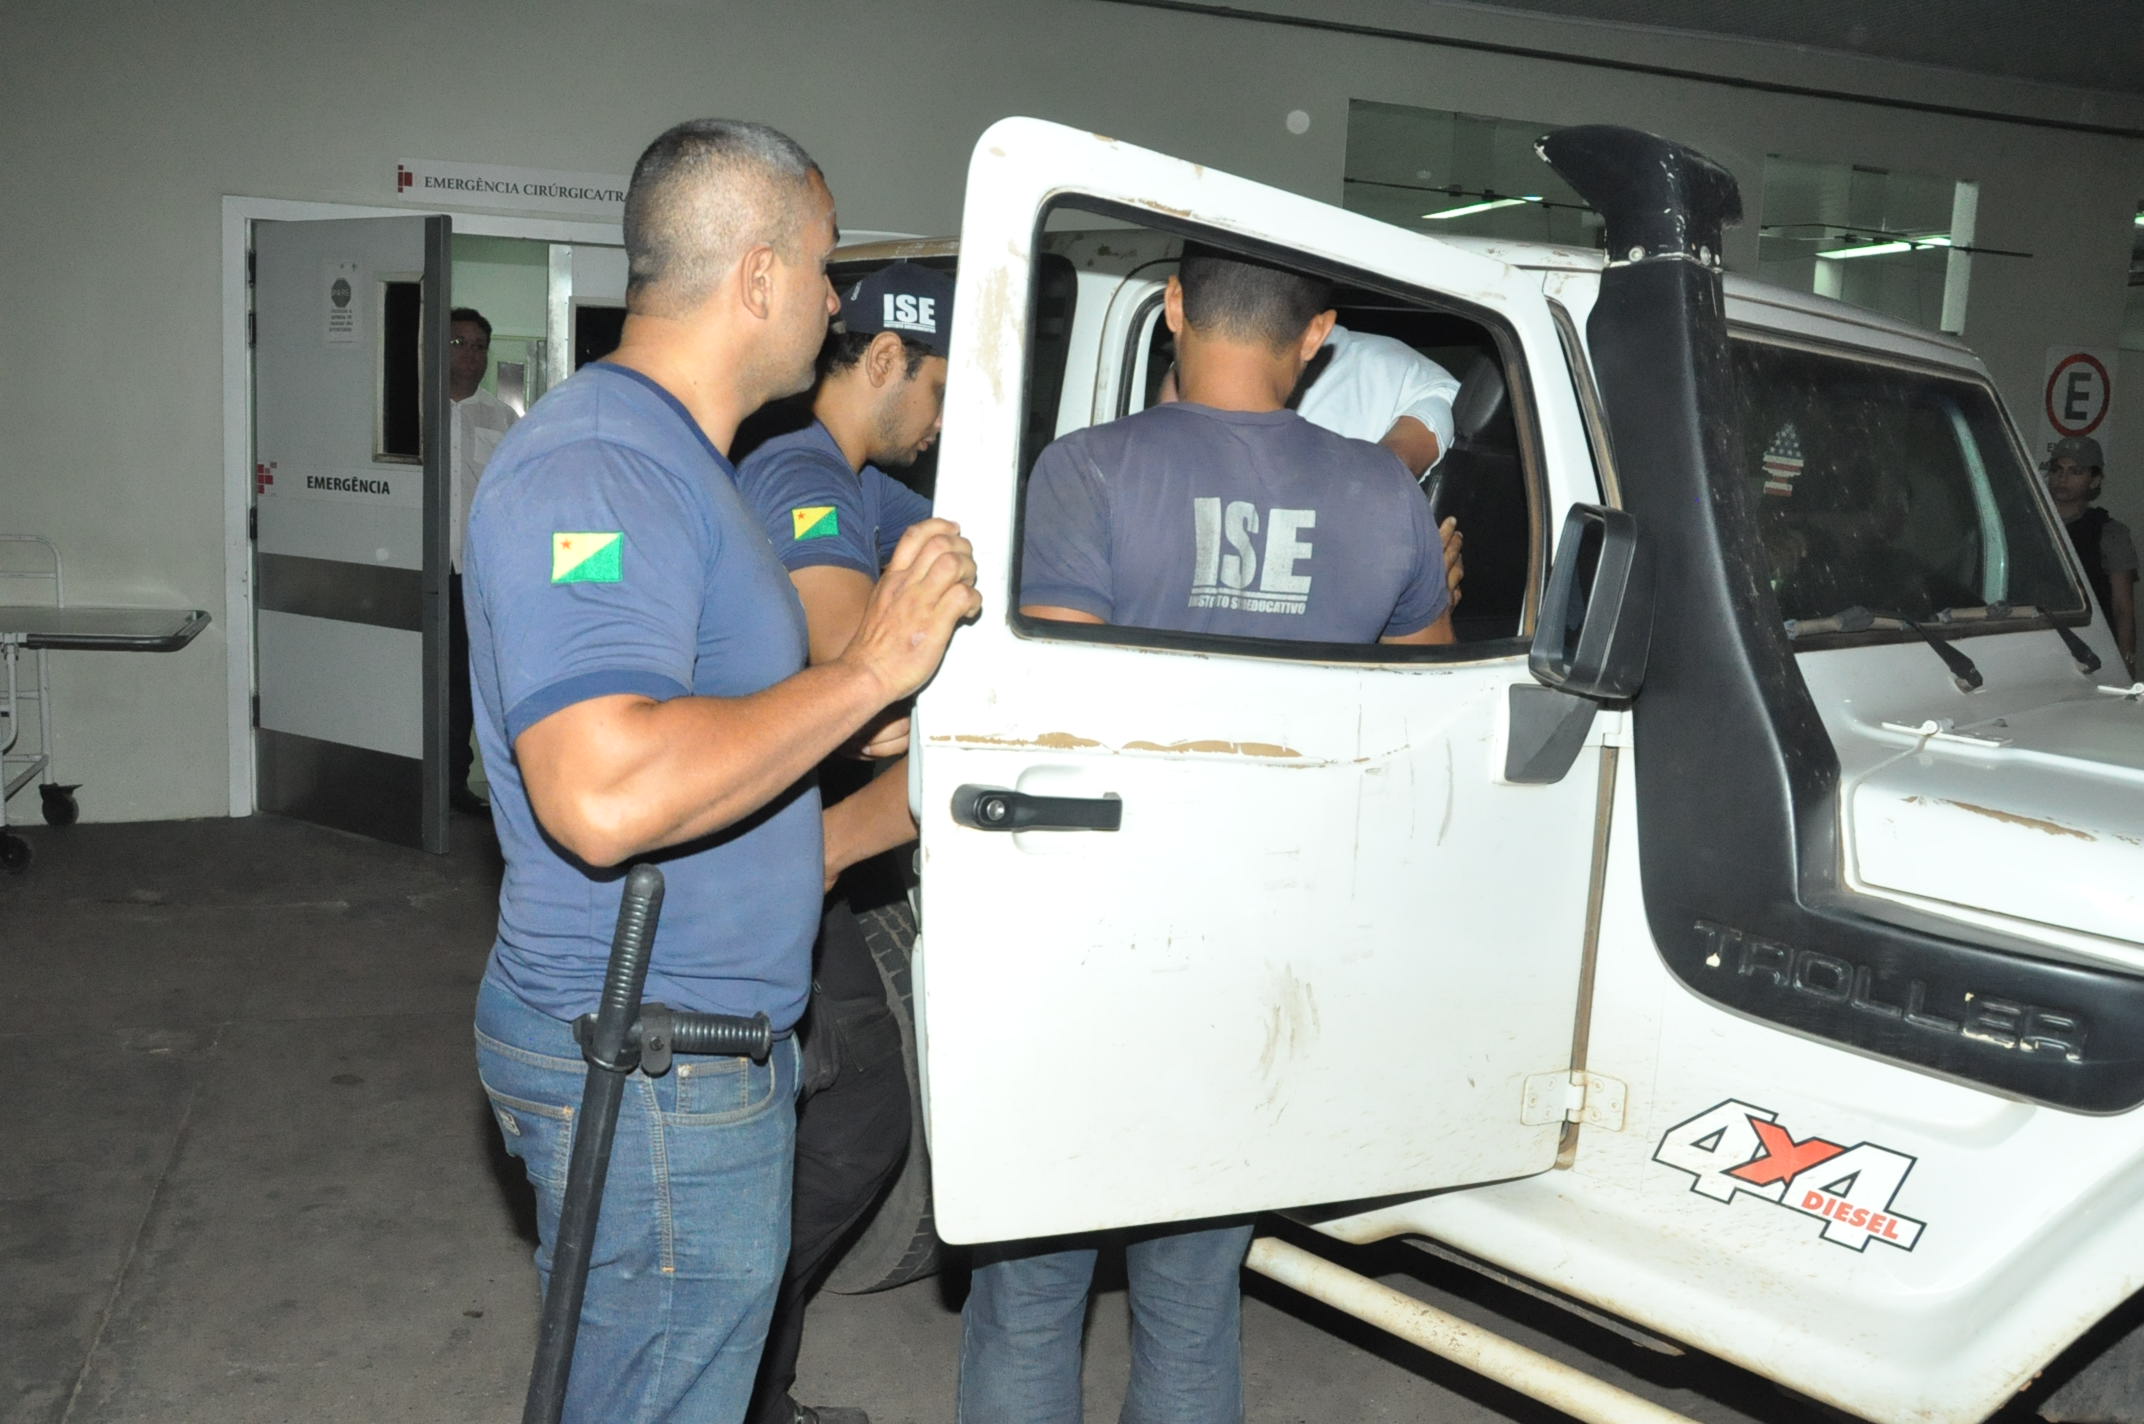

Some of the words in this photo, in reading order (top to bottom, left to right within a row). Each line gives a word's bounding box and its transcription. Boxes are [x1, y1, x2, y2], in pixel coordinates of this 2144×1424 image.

[424, 176, 519, 194] EMERGÊNCIA
[523, 183, 626, 202] CIRÚRGICA/TR
[883, 293, 936, 326] ISE
[2064, 371, 2092, 421] E
[306, 475, 390, 494] EMERGÊNCIA
[1193, 497, 1316, 593] ISE
[1694, 920, 2088, 1063] TROLLER
[1801, 1190, 1899, 1240] DIESEL
